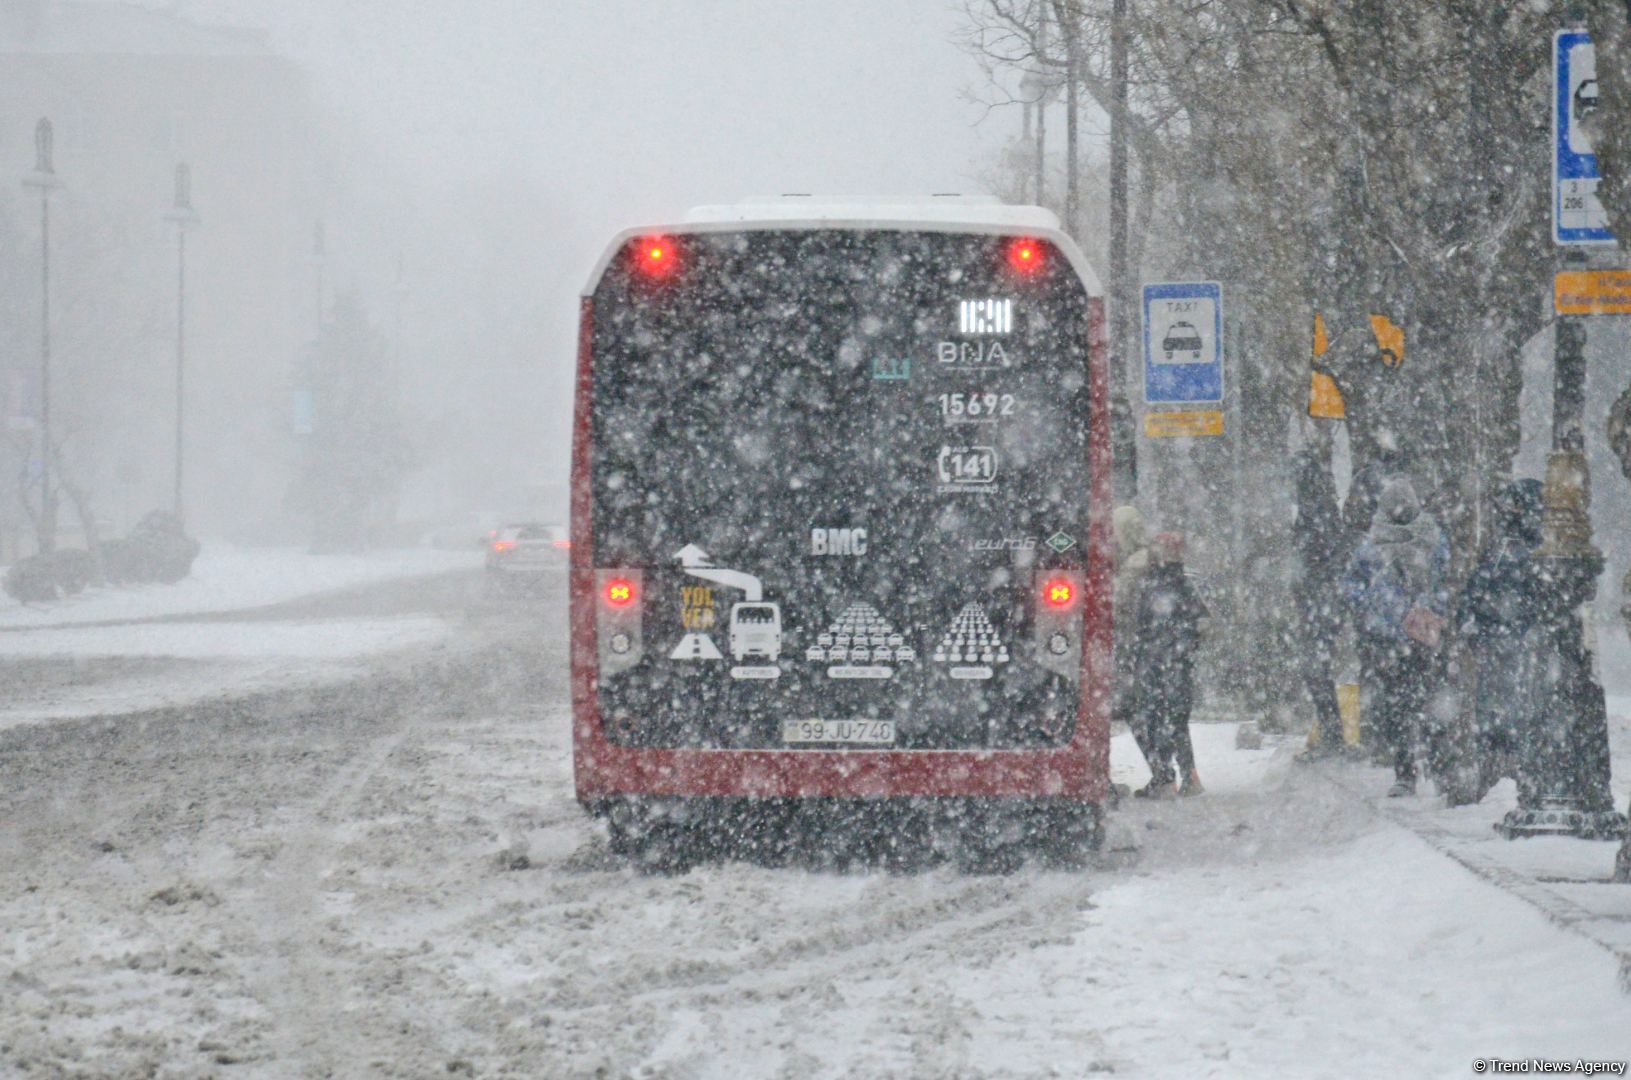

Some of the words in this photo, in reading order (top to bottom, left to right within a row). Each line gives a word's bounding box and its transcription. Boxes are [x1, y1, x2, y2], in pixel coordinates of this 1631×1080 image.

[1166, 301, 1198, 313] TAXI
[938, 393, 1015, 416] 15692
[951, 454, 991, 477] 141
[811, 528, 867, 556] BMC
[681, 587, 714, 608] YOL
